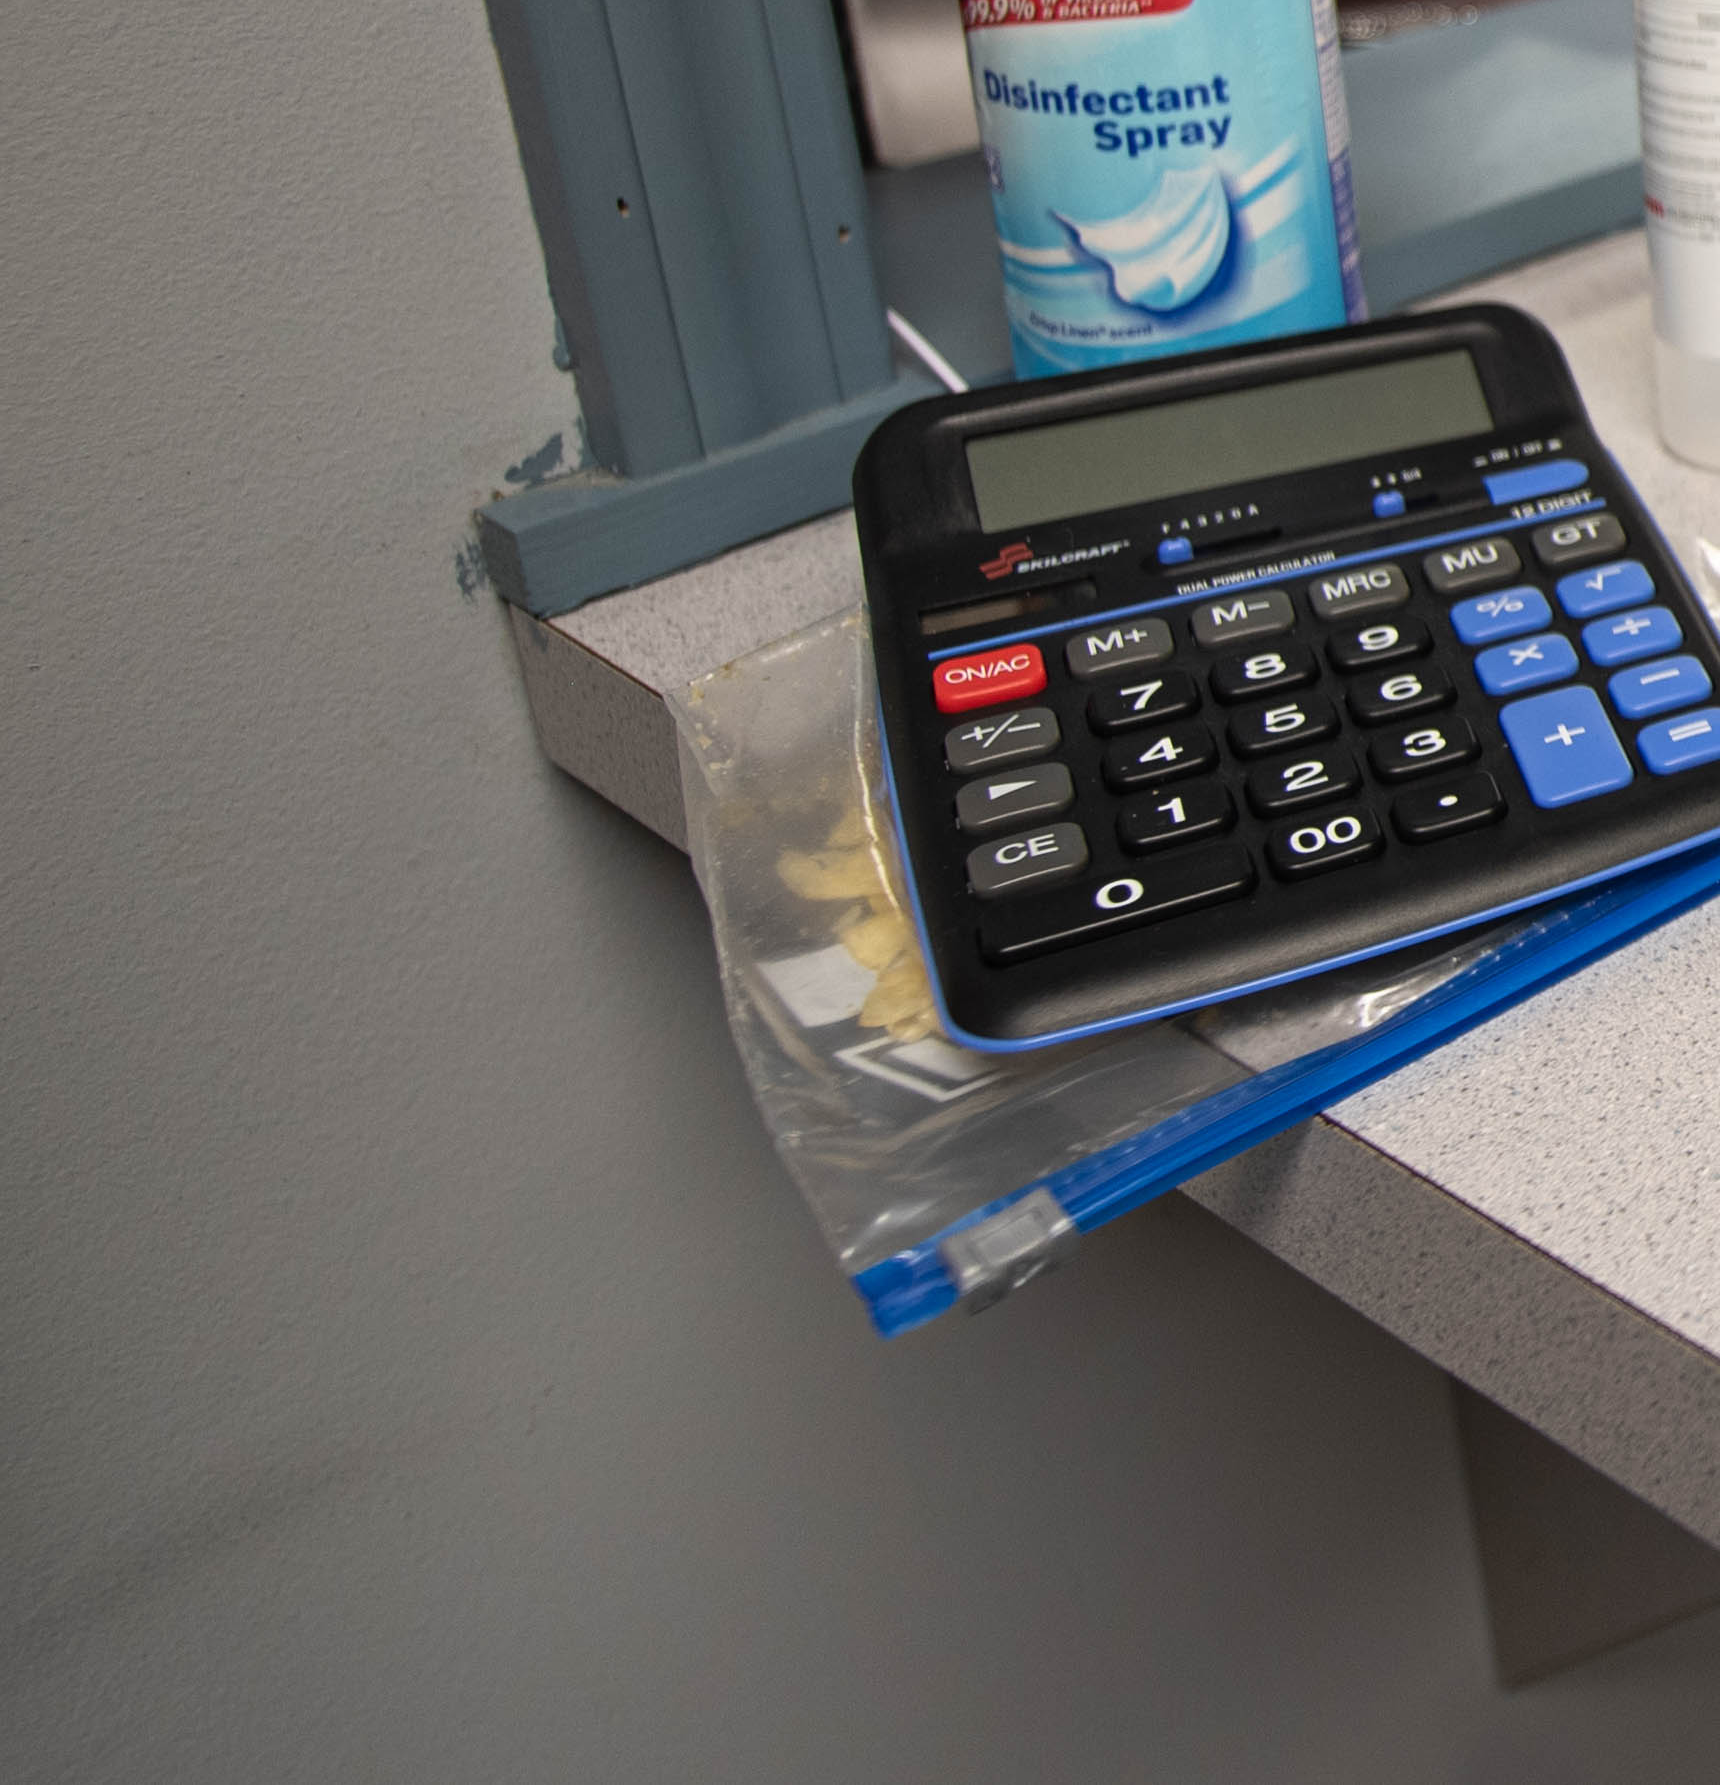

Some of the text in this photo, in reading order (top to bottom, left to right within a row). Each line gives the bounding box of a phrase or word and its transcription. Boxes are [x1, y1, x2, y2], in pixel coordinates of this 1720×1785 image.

[983, 68, 1230, 115] Disinfectant
[1094, 115, 1232, 158] Spray
[1536, 488, 1593, 515] DIGIT
[1551, 519, 1600, 547] GT
[1016, 542, 1123, 574] SKILCRAFT
[1177, 551, 1337, 596] DUAL POWER CALCULATOR
[1441, 543, 1499, 574] MU
[1320, 569, 1392, 601] MRC
[1086, 628, 1147, 656] M+
[1358, 624, 1399, 652] 9
[944, 653, 1031, 685] ON/AC
[1244, 652, 1286, 680] 8
[1120, 679, 1163, 710] 7
[1380, 674, 1422, 702] 6
[1264, 704, 1306, 733] 5
[1139, 736, 1183, 763] 4
[1403, 729, 1446, 757] 3
[1282, 760, 1329, 792] 2
[1158, 797, 1186, 824] 1
[994, 832, 1060, 864] CE
[1289, 815, 1362, 854] 00
[1095, 877, 1144, 910] 0
